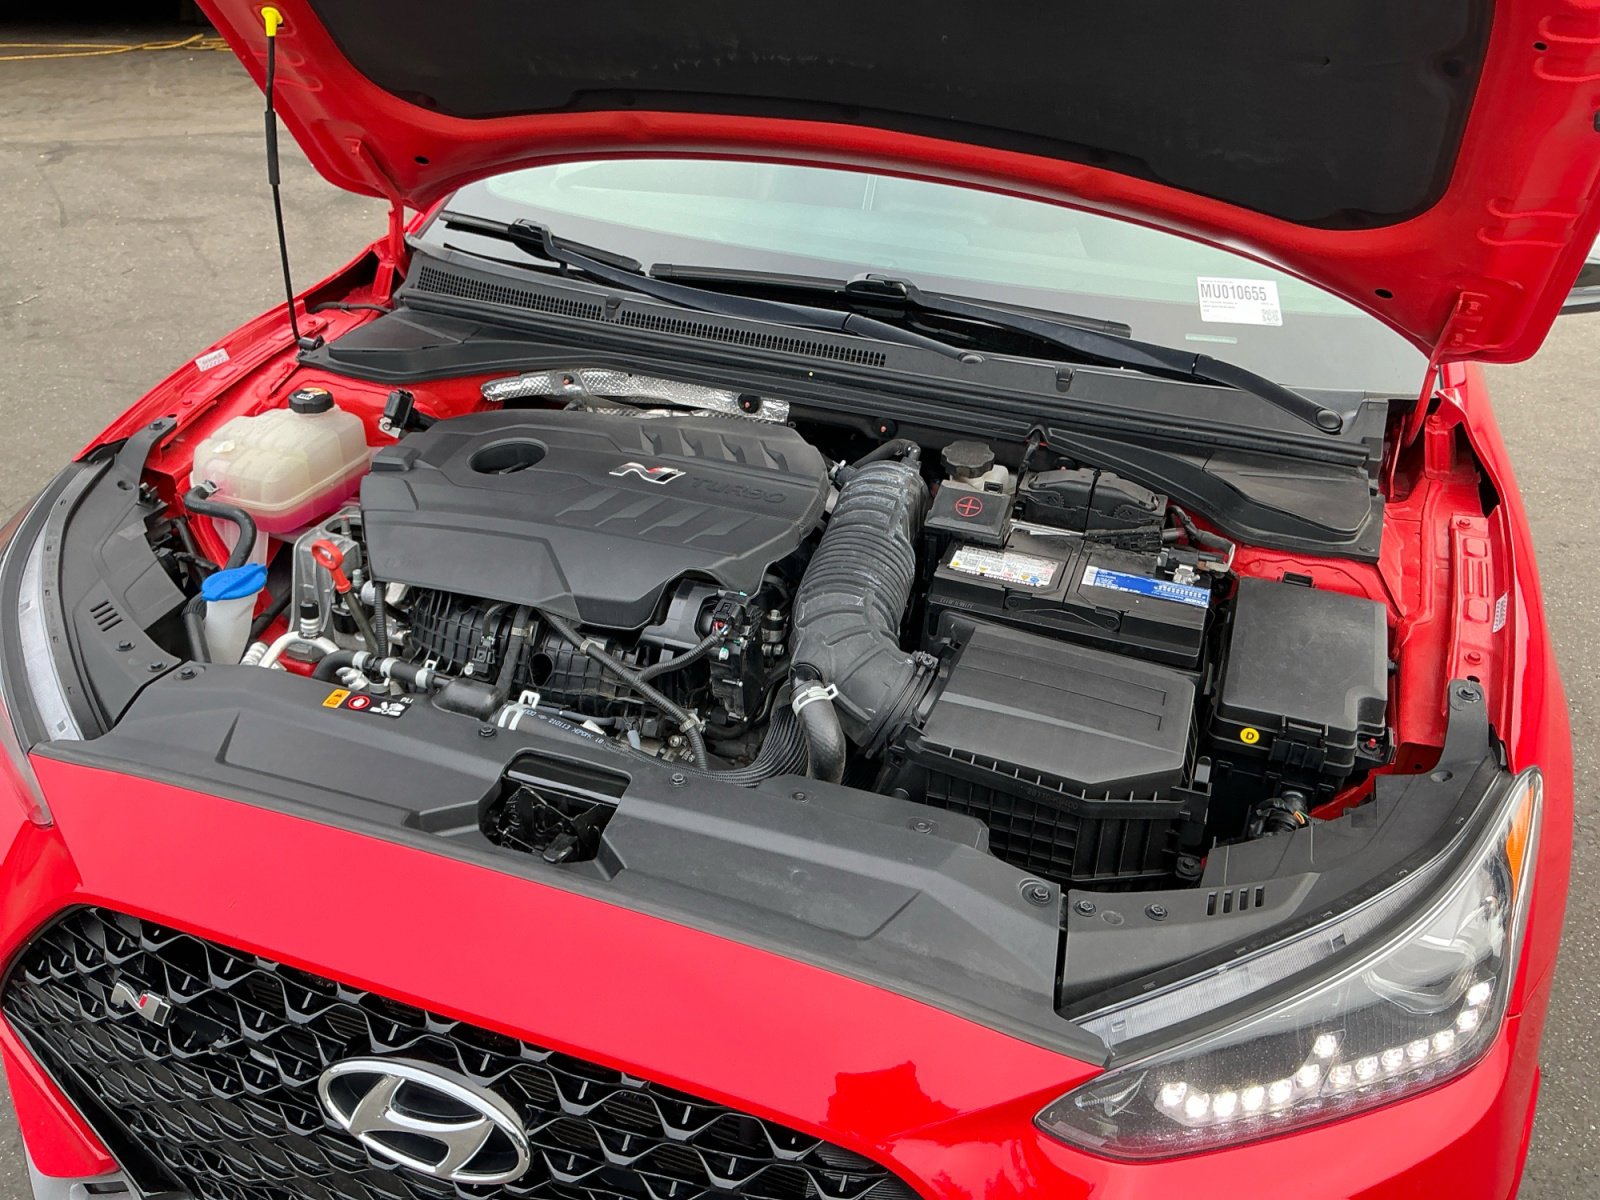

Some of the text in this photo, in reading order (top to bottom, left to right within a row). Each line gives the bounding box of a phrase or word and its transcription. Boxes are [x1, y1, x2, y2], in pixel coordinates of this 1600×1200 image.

[1200, 283, 1267, 301] MU010655
[692, 477, 787, 503] TURBO
[1245, 731, 1255, 741] D
